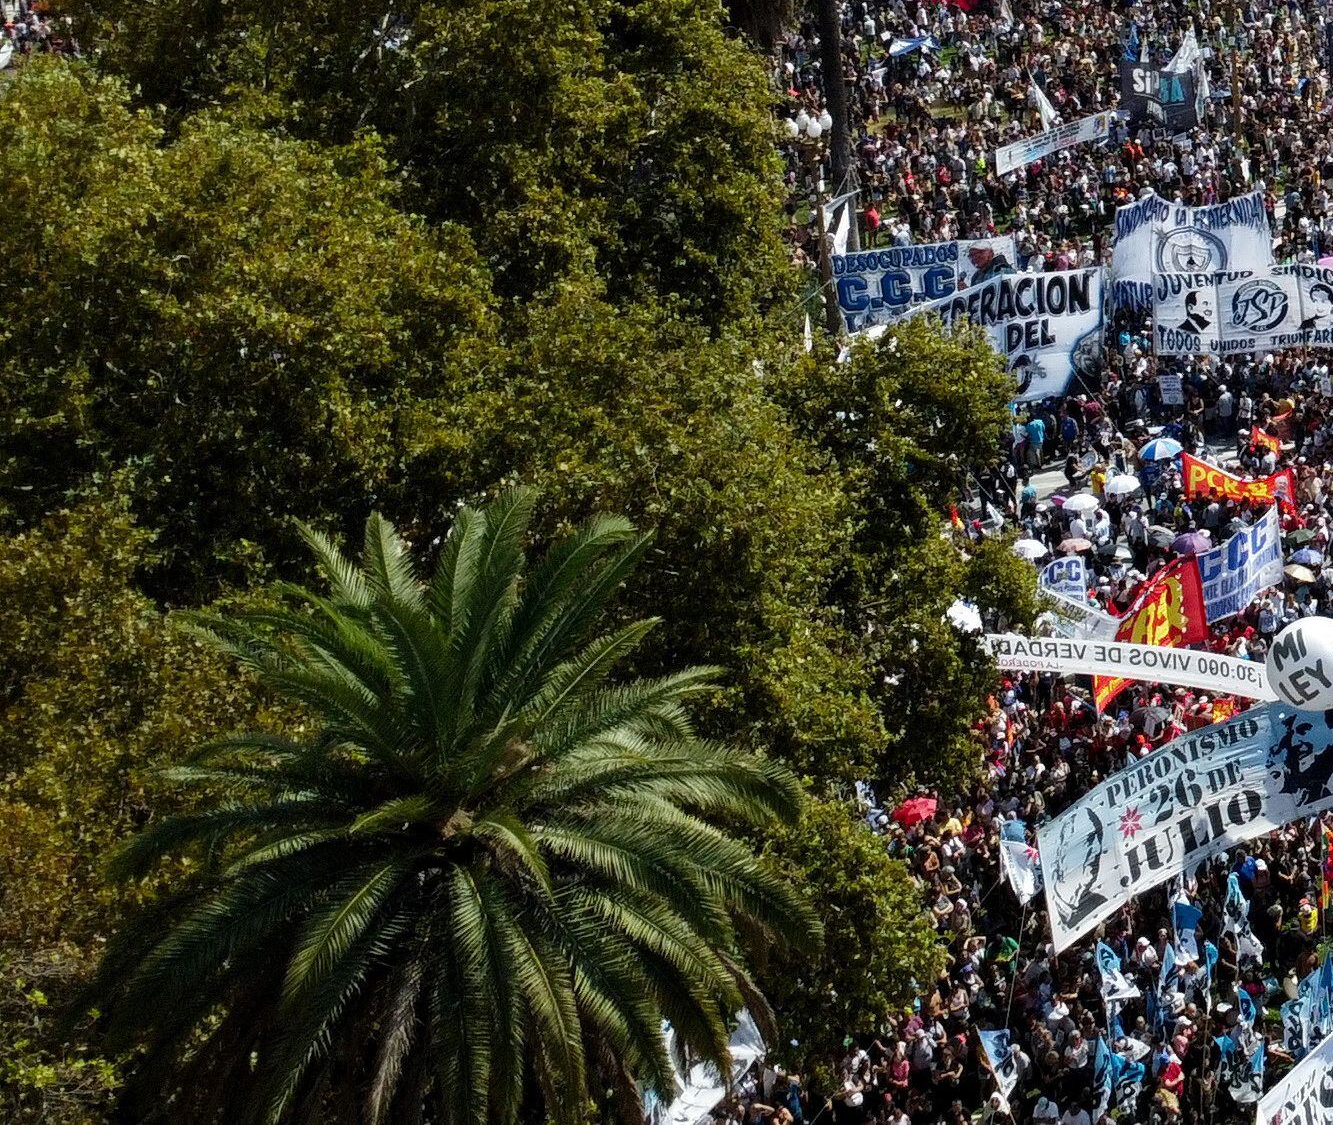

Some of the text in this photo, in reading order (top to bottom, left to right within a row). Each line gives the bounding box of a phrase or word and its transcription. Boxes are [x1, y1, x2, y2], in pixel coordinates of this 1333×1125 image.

[833, 240, 959, 275] DESOCUPADOS
[1156, 269, 1254, 303] JUVENTUD
[1004, 317, 1057, 353] DEL
[1156, 326, 1201, 352] TODOS
[1209, 337, 1257, 352] UNIDOS
[1272, 627, 1307, 672] MI
[1278, 658, 1333, 708] LEY
[1105, 719, 1261, 808] PERONISMO
[1150, 759, 1245, 826] 26 DE
[1118, 789, 1263, 888] JULIO
